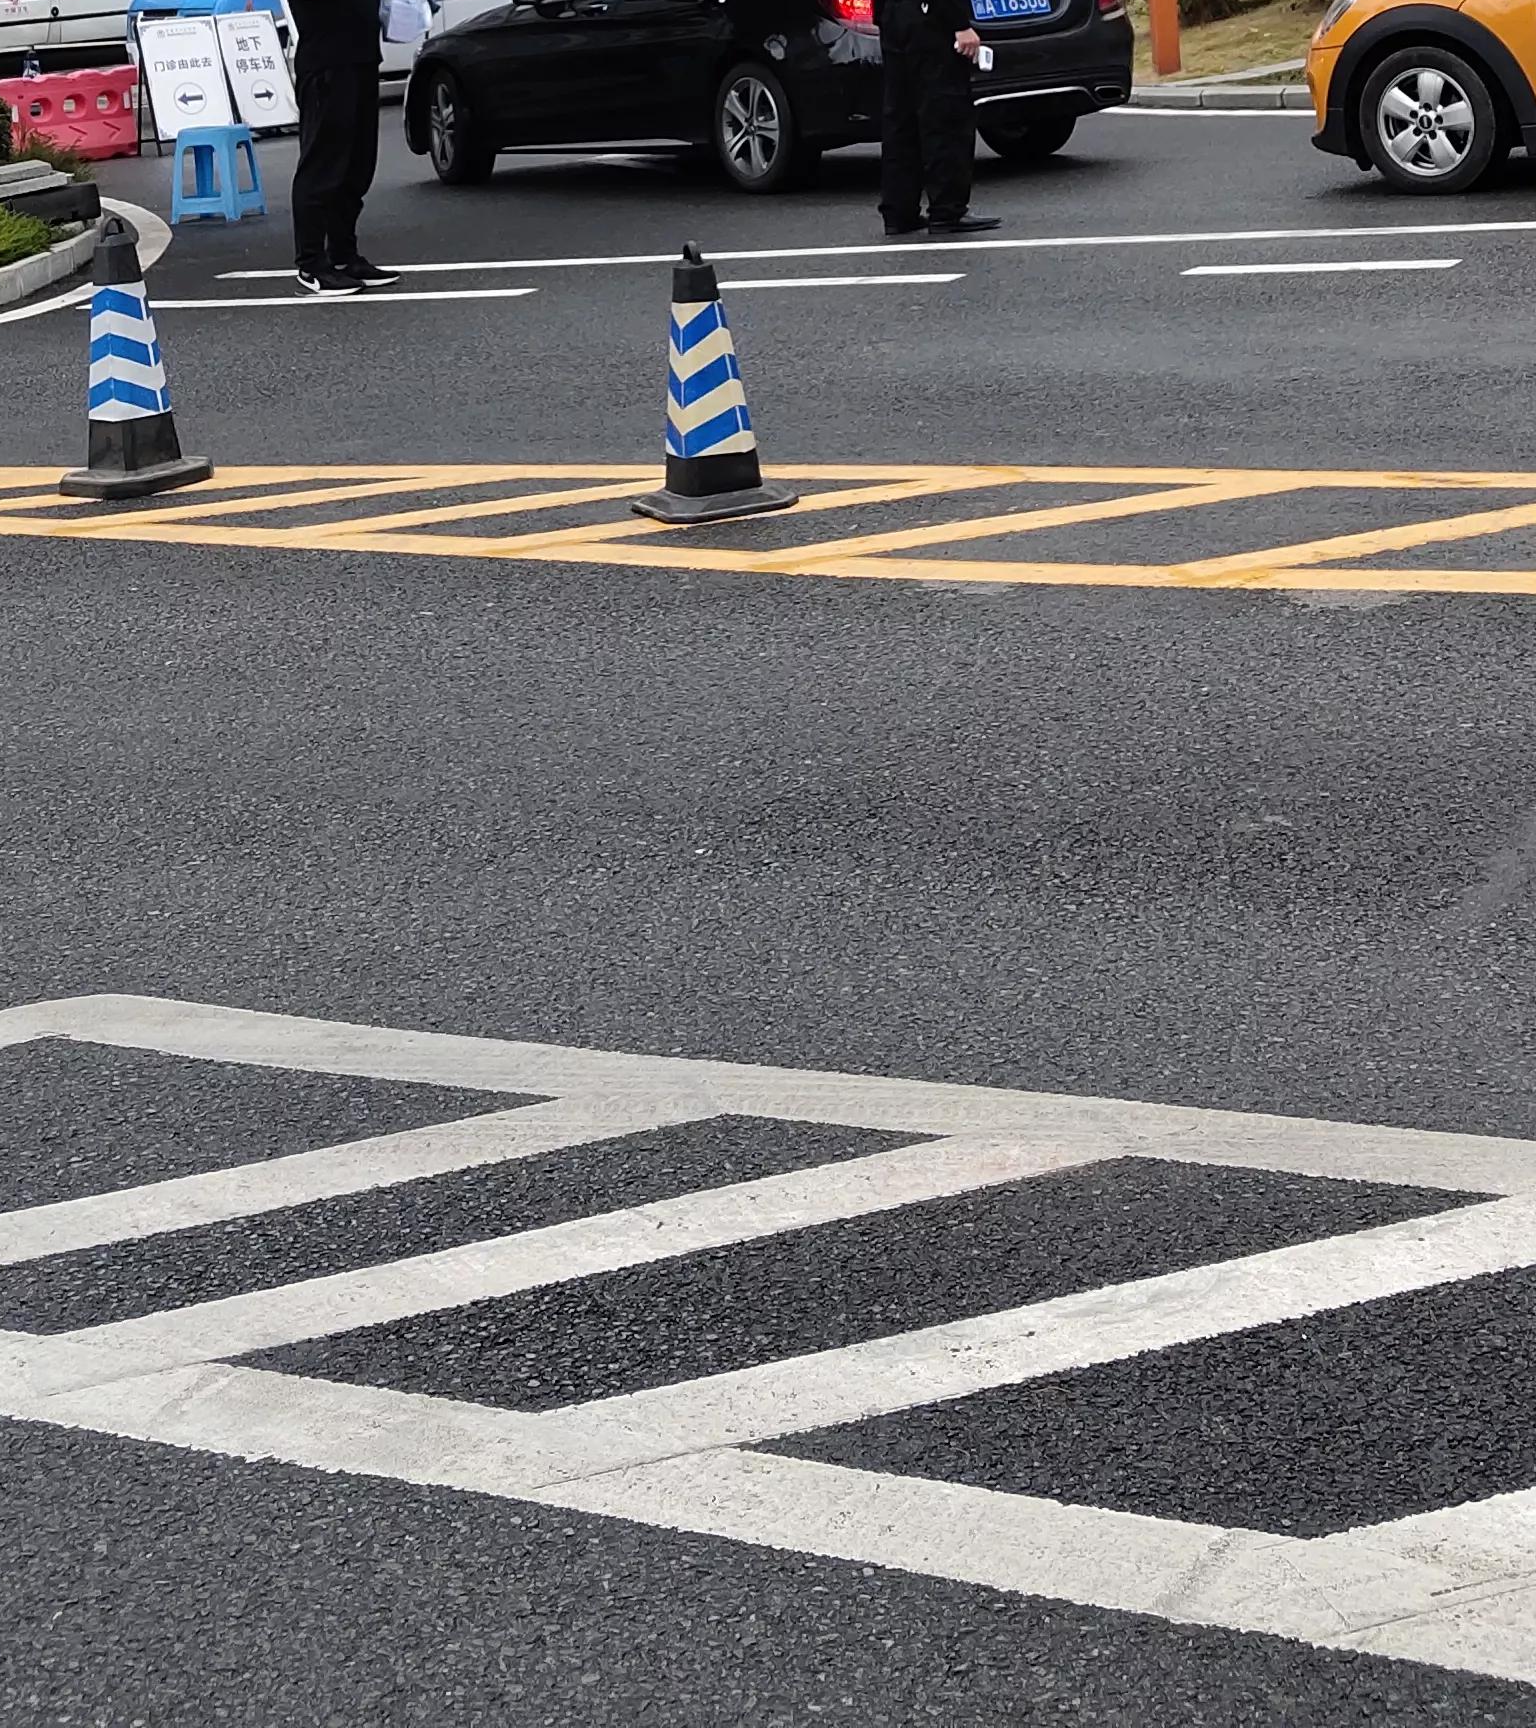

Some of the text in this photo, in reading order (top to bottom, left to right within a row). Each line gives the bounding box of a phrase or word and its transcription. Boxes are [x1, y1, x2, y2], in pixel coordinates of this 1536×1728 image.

[235, 35, 262, 52] 地下
[154, 57, 213, 72] 门诊由此去
[235, 55, 276, 74] 停车场
